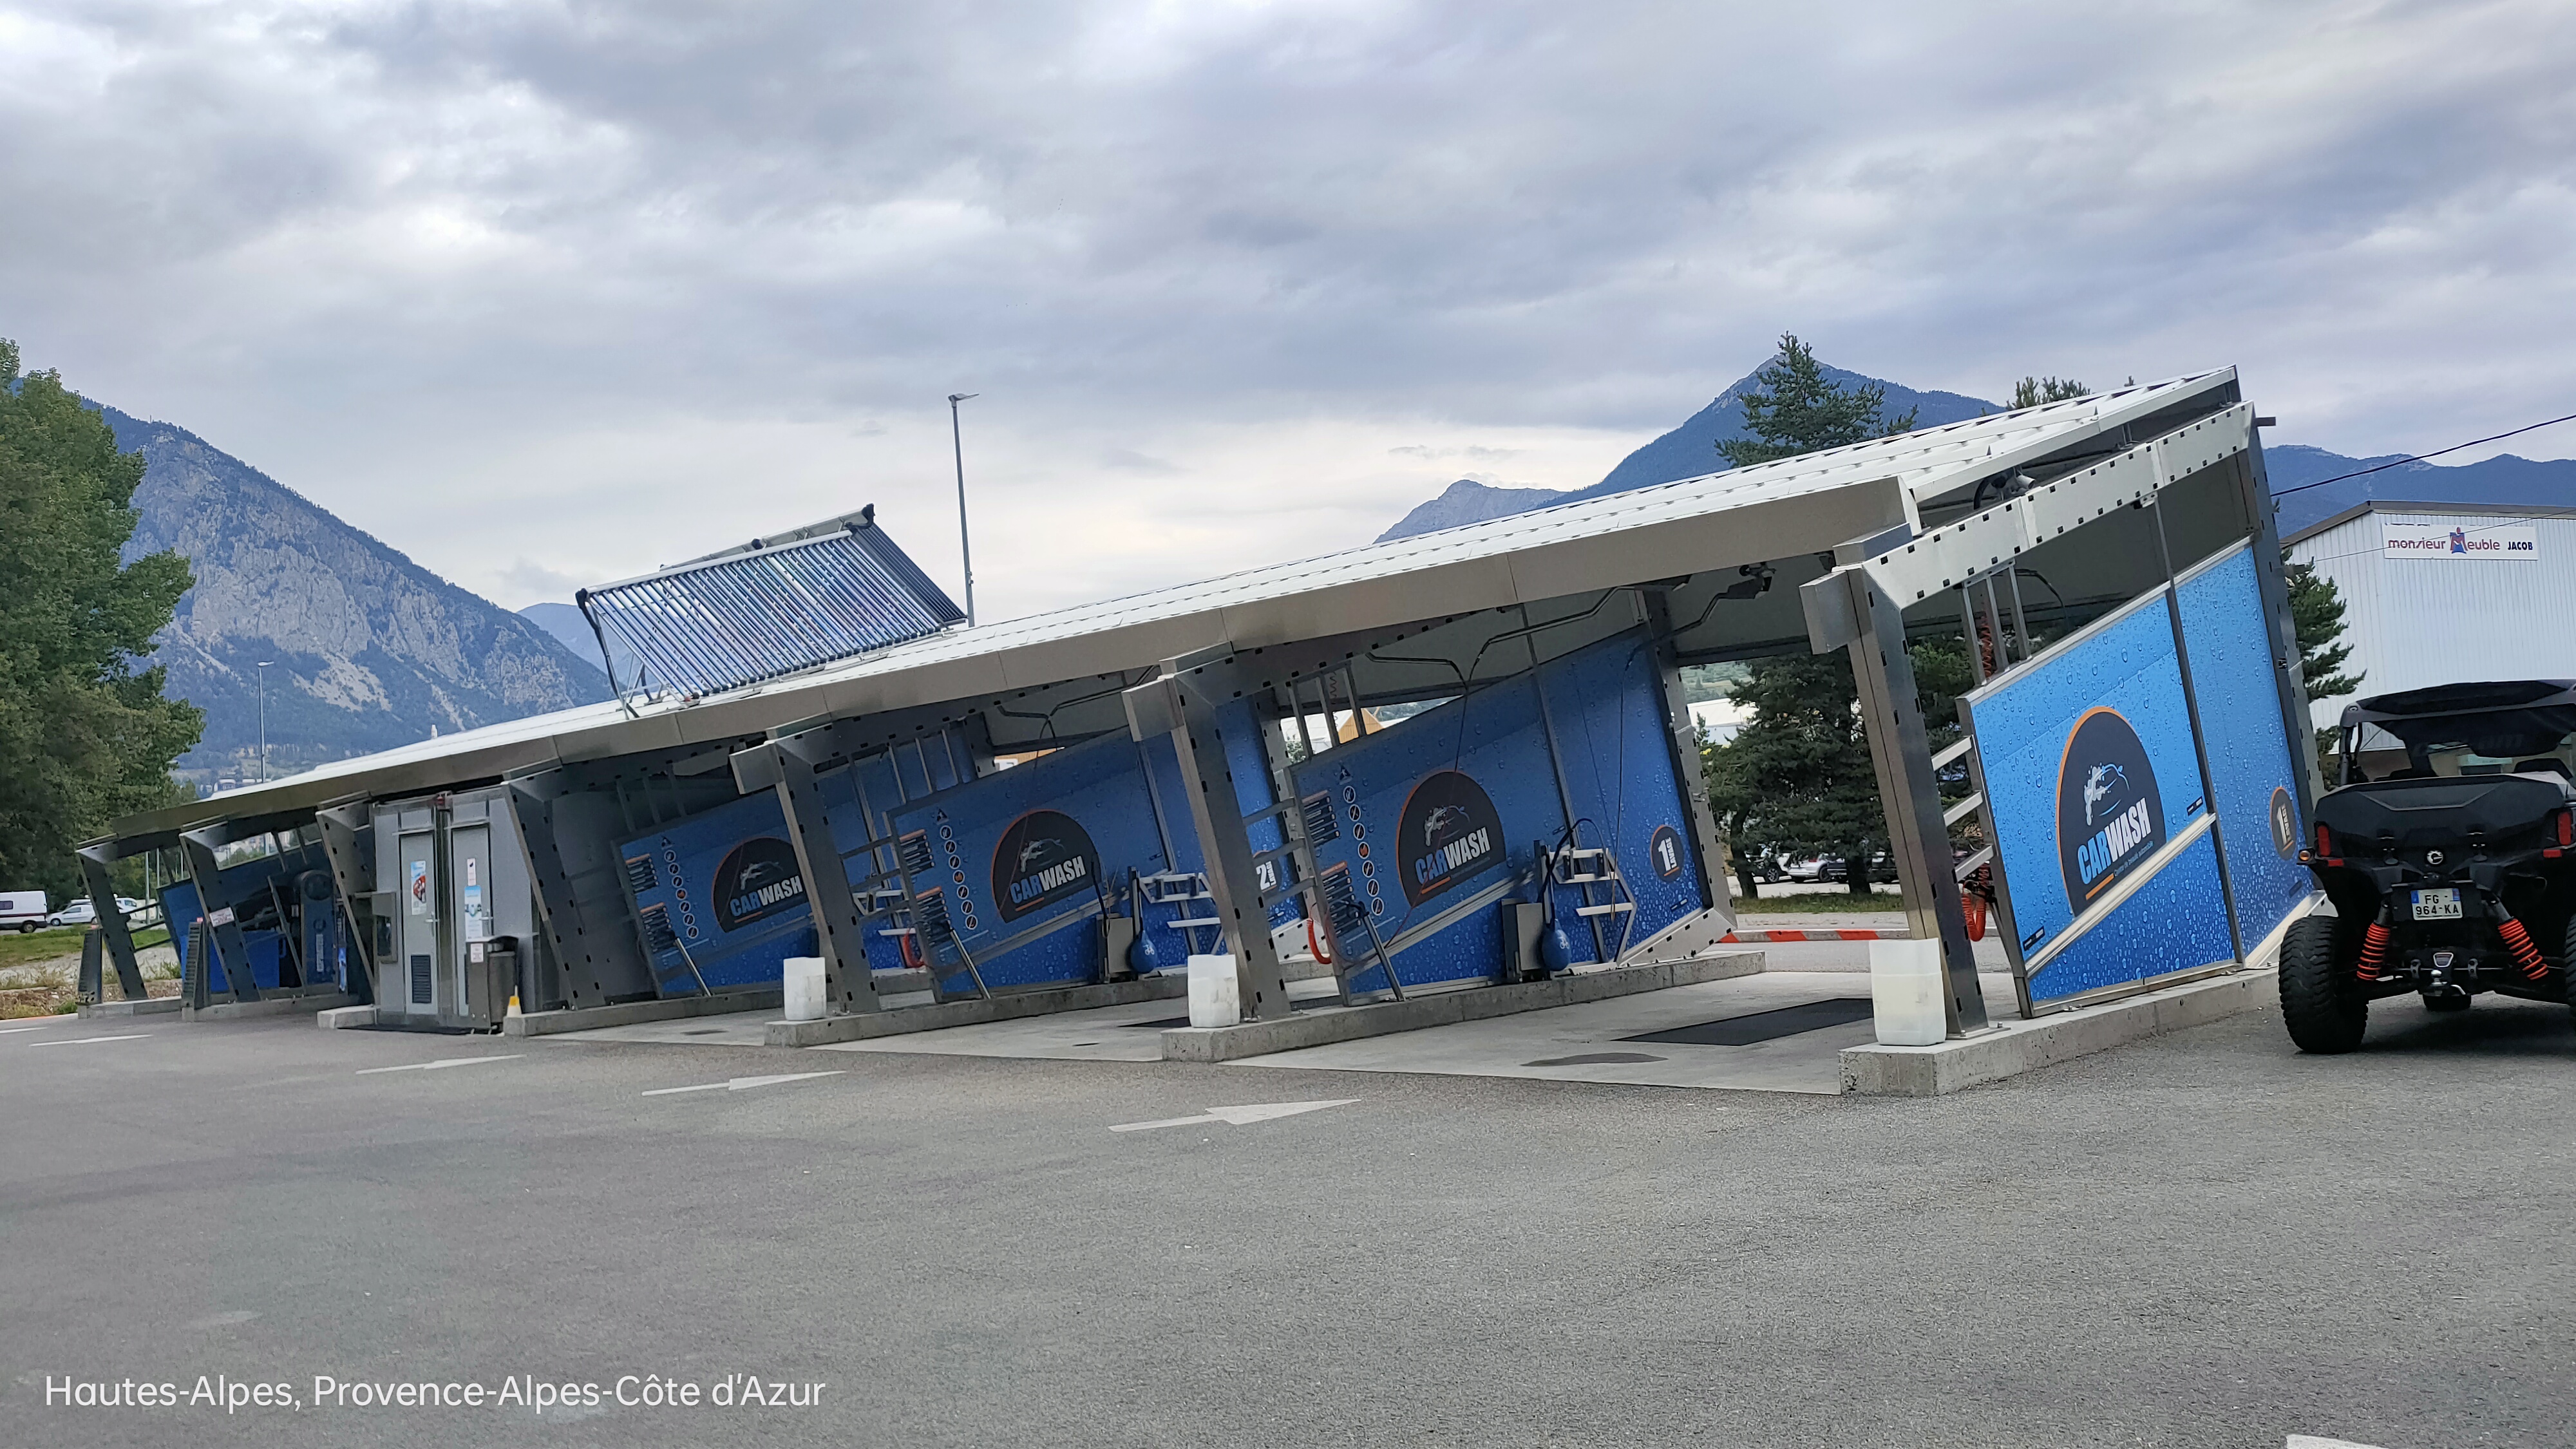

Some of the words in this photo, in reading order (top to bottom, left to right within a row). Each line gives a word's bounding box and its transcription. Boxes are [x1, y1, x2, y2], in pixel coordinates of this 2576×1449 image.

[2388, 537, 2446, 550] monsieur
[2508, 541, 2533, 551] JACOB
[1415, 826, 1491, 885] CARWASH
[1658, 839, 1672, 872] 1
[2078, 797, 2152, 884] CARWASH
[730, 875, 803, 916] CARWASH
[1010, 855, 1086, 904] CARWASH
[1256, 864, 1271, 890] 2
[2416, 904, 2459, 915] 964-KA
